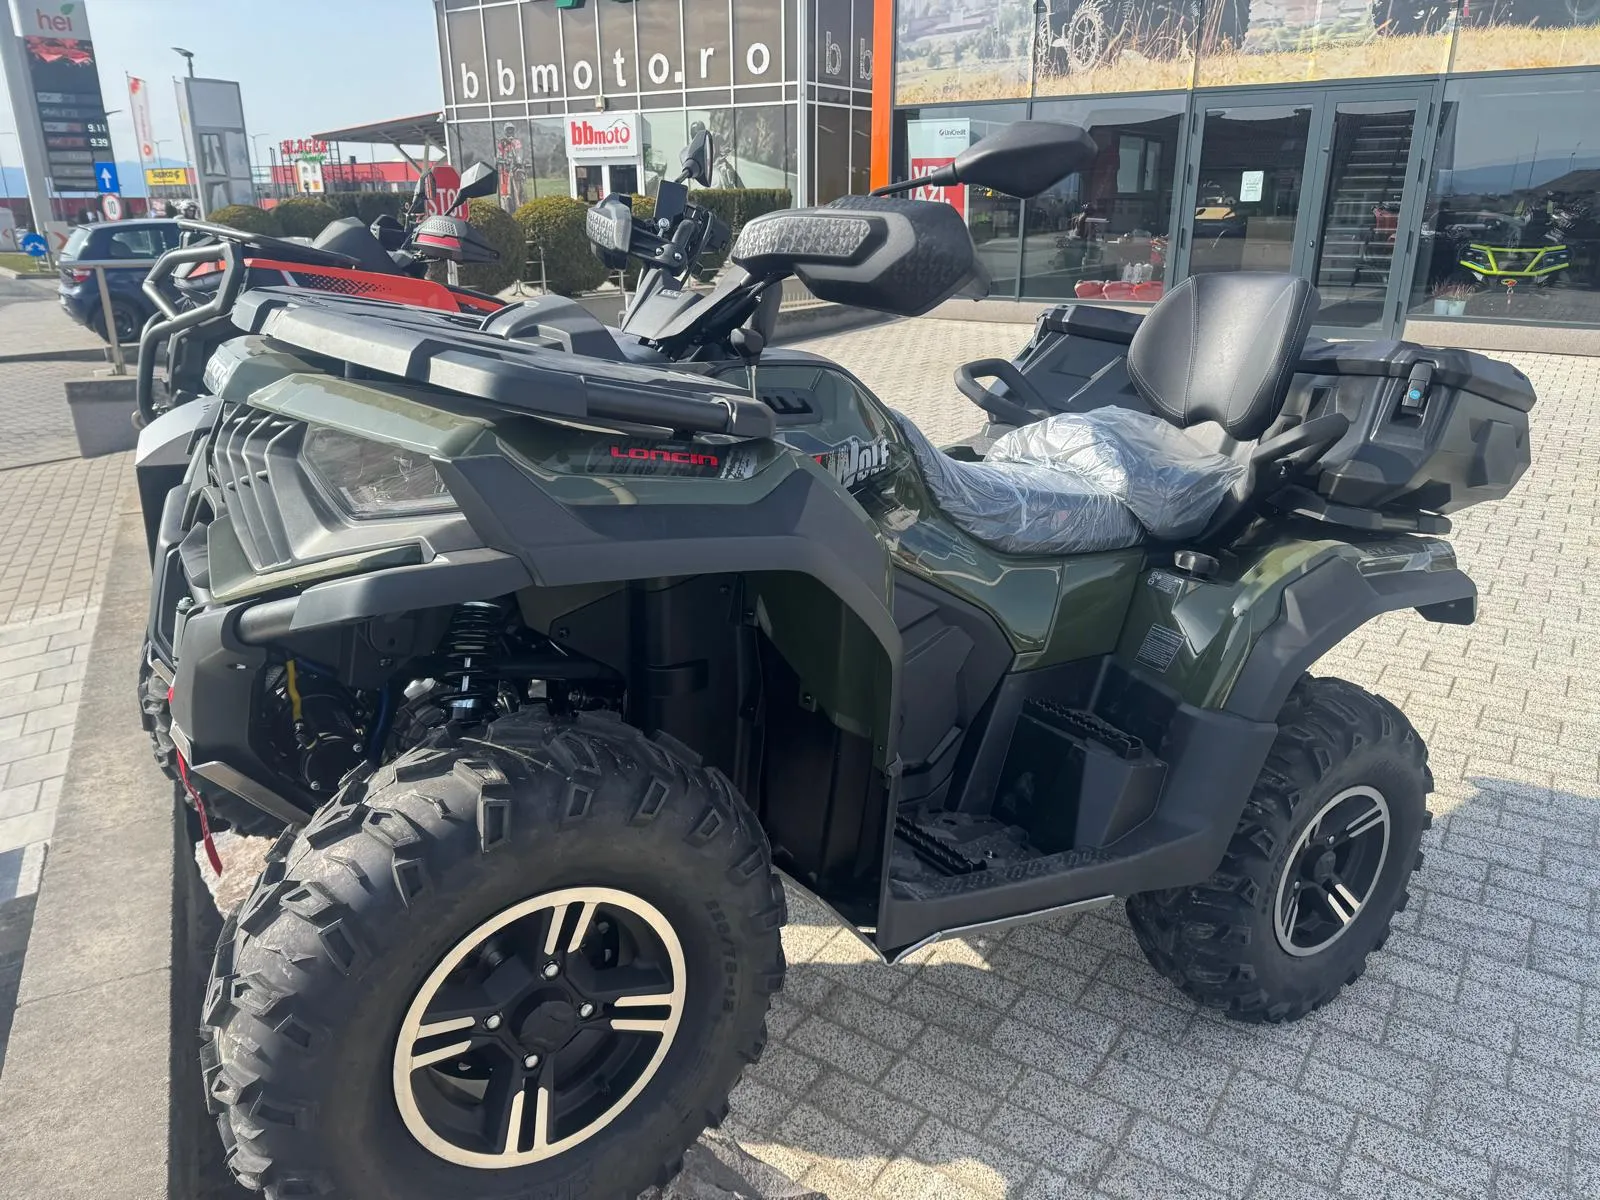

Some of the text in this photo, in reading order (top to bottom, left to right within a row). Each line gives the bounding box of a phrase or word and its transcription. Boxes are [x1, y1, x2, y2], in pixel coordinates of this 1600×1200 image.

[36, 7, 73, 32] hei
[87, 124, 106, 132] 9.11
[571, 120, 630, 145] bbmoto
[107, 201, 116, 214] 10
